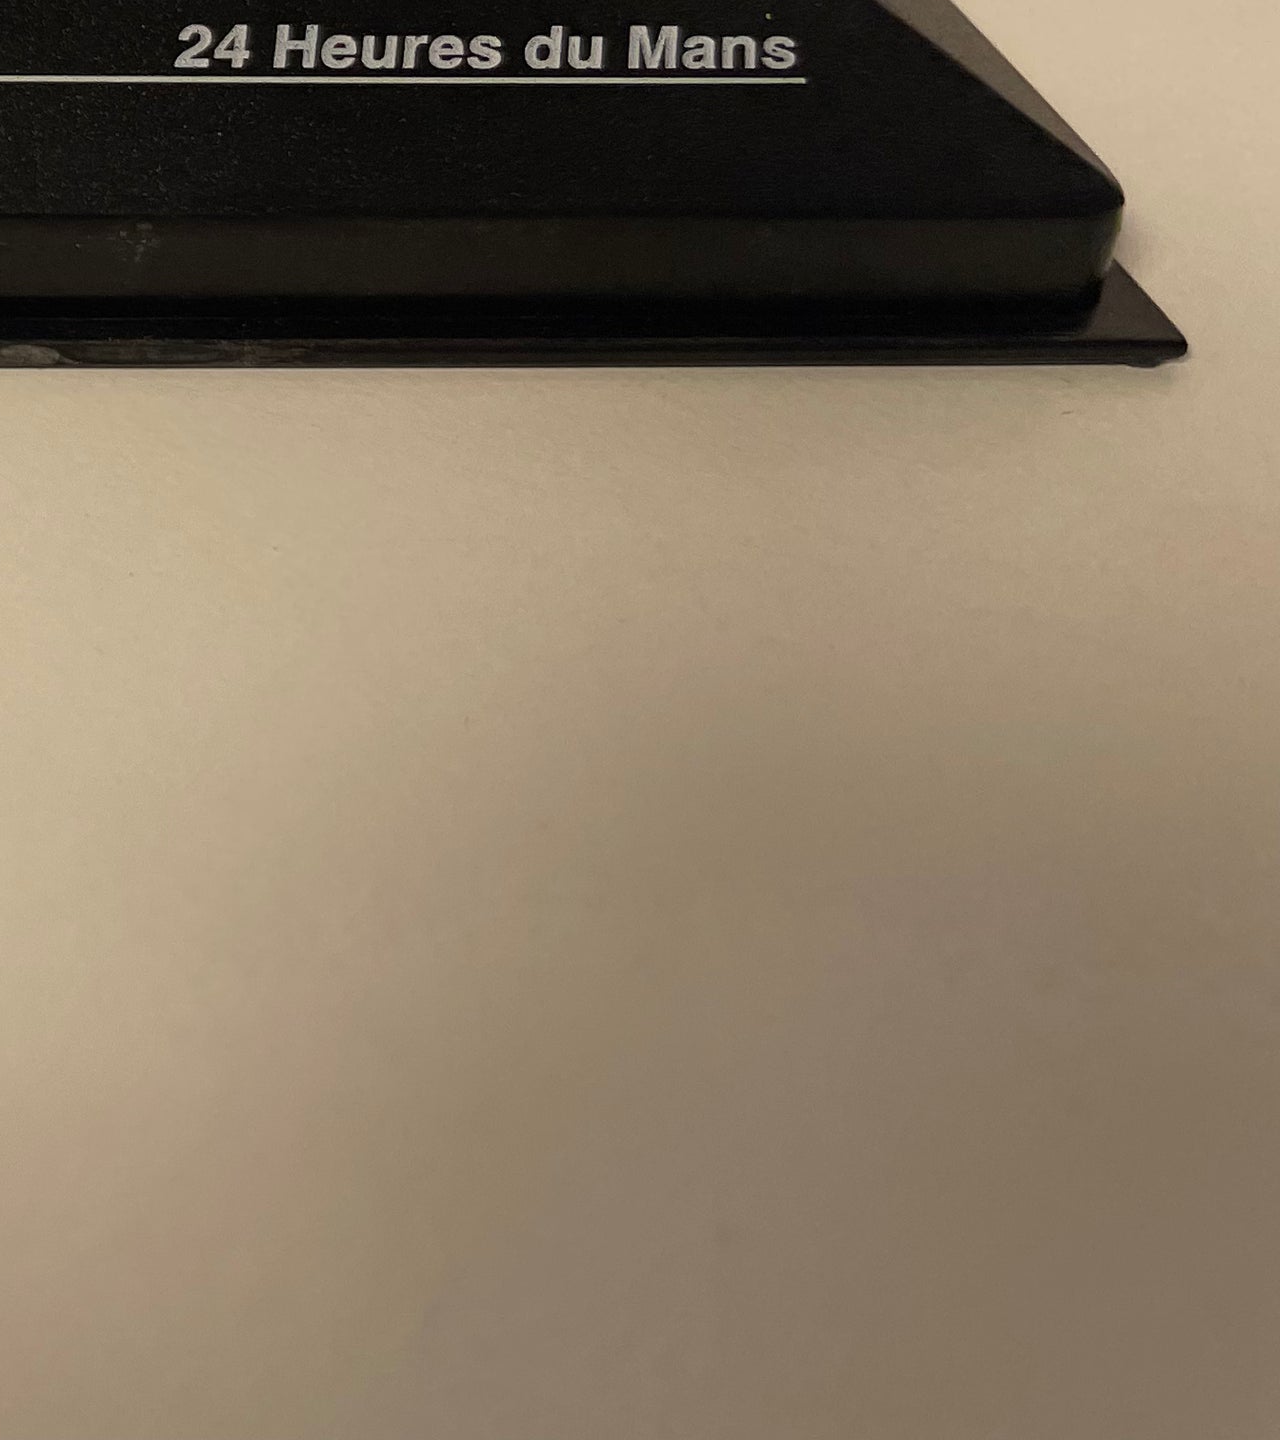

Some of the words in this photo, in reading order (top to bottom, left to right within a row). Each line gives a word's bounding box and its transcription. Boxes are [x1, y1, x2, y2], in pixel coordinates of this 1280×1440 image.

[174, 24, 251, 69] 24
[273, 24, 504, 69] Heures
[524, 25, 604, 70] du
[627, 25, 797, 70] Mans
